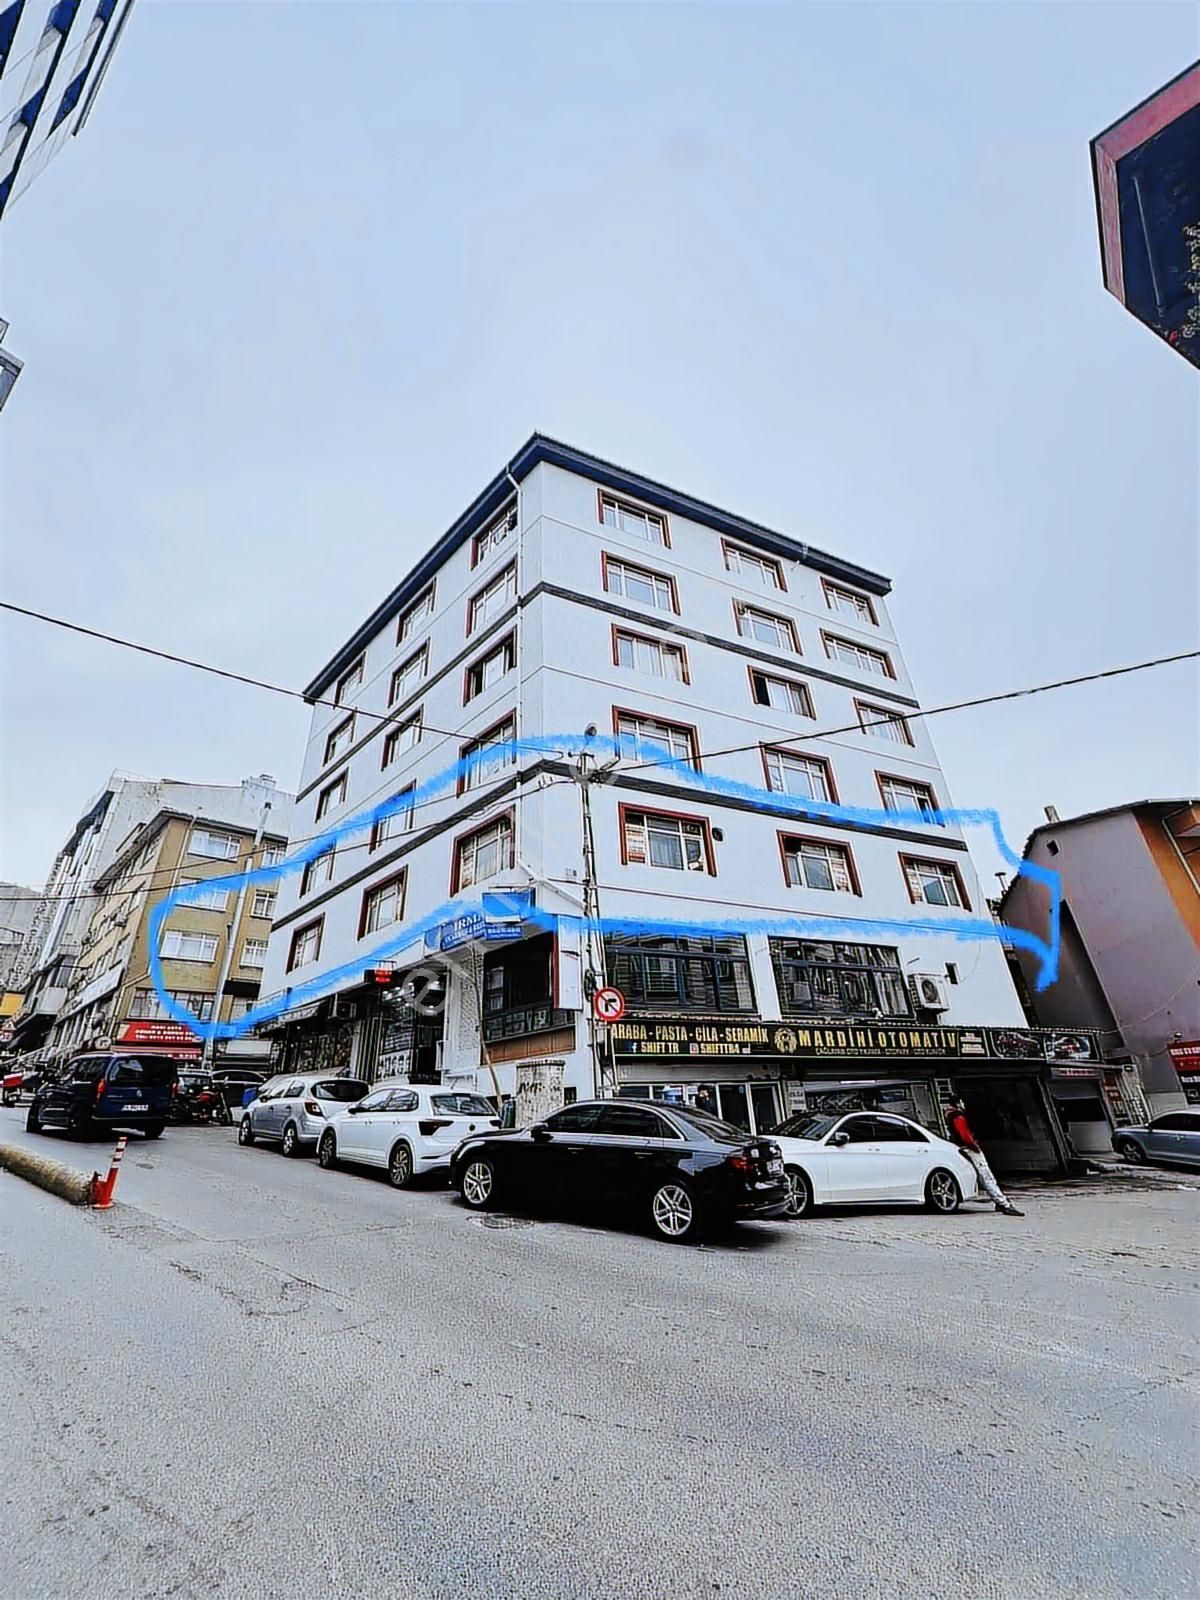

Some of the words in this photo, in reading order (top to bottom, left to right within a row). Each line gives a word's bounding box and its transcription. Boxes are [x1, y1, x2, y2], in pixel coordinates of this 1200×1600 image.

[610, 1023, 648, 1040] ARABA
[655, 1025, 688, 1041] PASTA
[695, 1023, 719, 1042] CİLA
[725, 1025, 769, 1043] SERAMİK
[798, 1028, 873, 1048] MARDİNİ
[878, 1029, 957, 1049] OTOMATİV
[641, 1042, 666, 1053] SHIFT
[667, 1042, 679, 1054] TR
